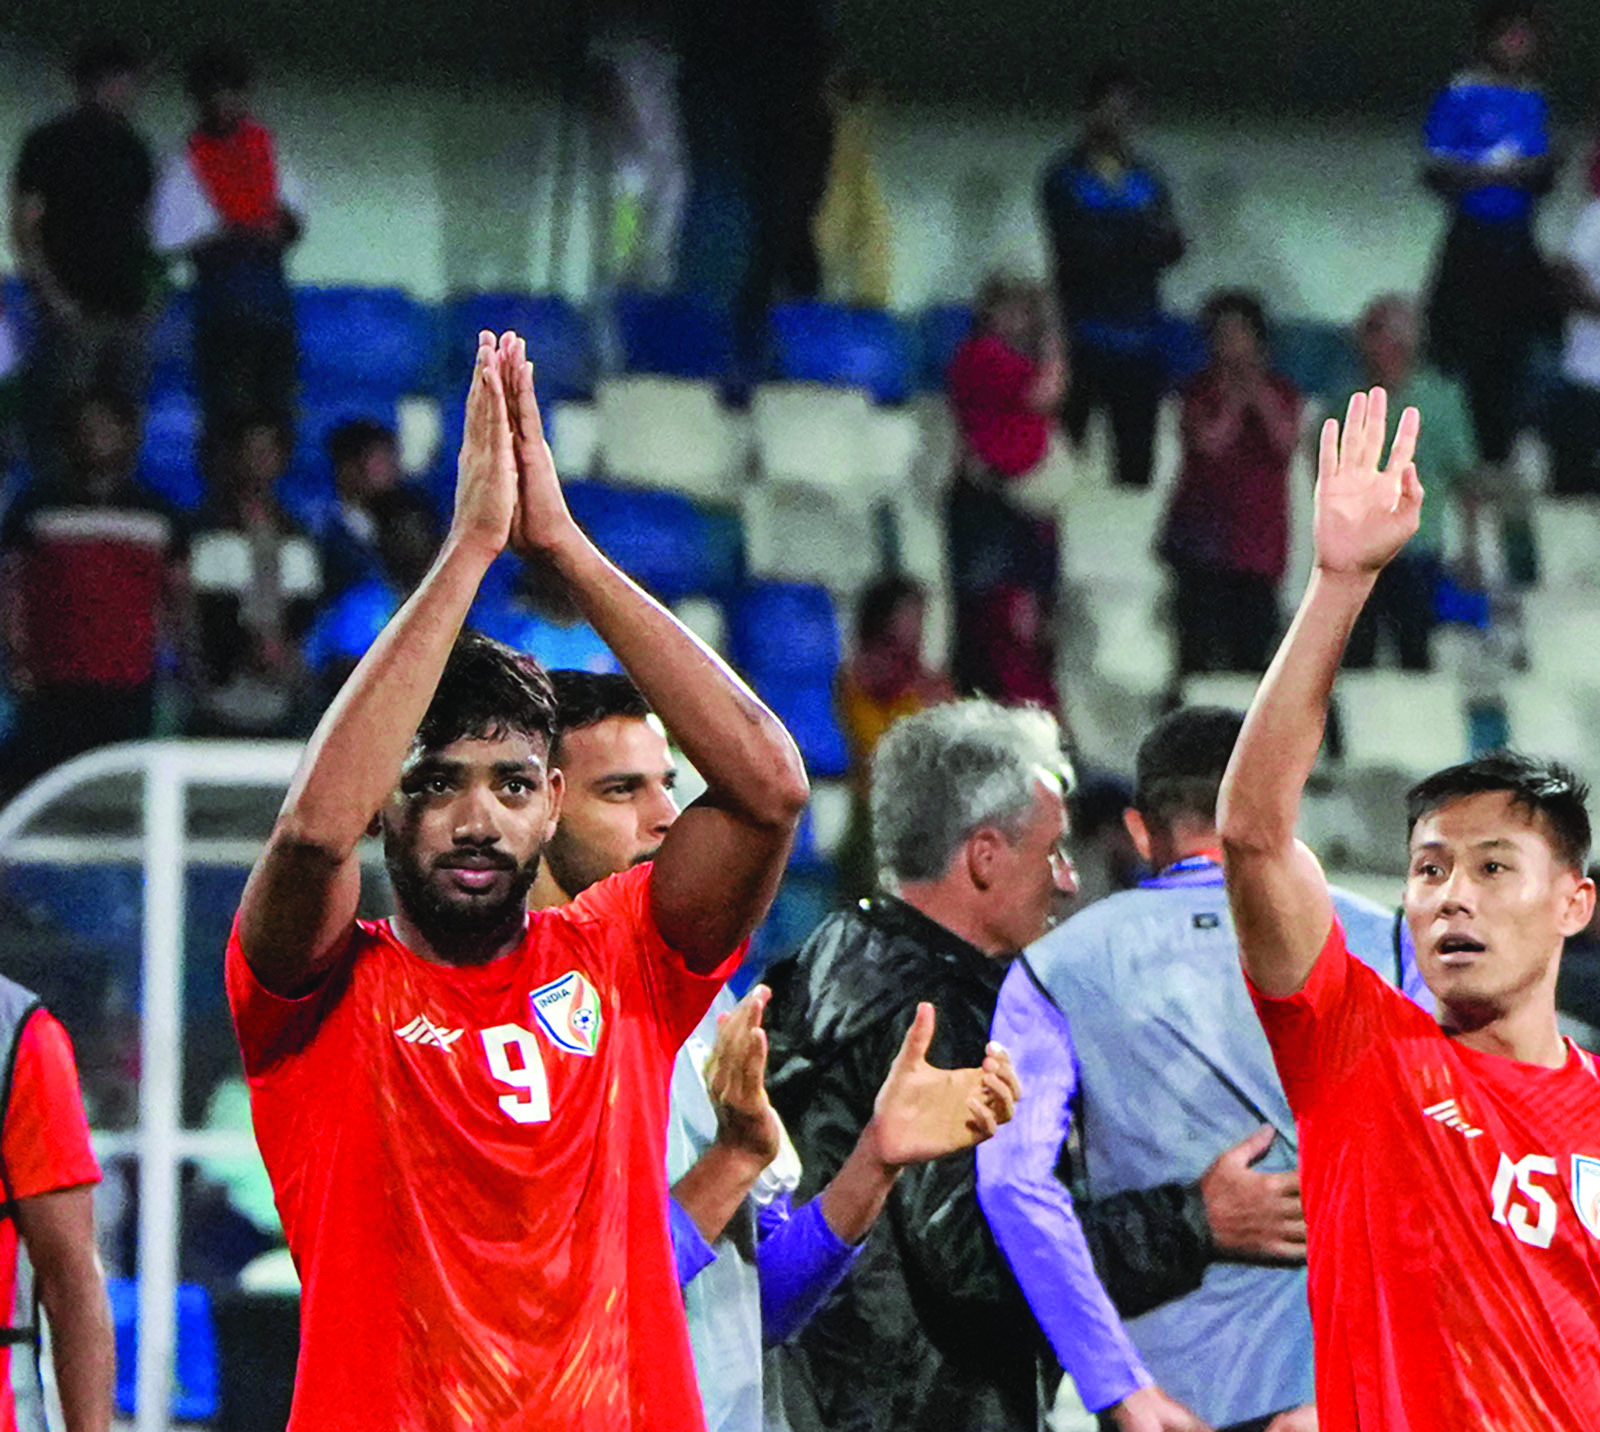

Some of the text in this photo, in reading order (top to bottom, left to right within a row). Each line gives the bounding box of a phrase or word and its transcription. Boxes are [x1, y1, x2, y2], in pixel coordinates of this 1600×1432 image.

[539, 988, 571, 1009] INDIA
[480, 1023, 551, 1123] 9
[1491, 1152, 1557, 1249] 15
